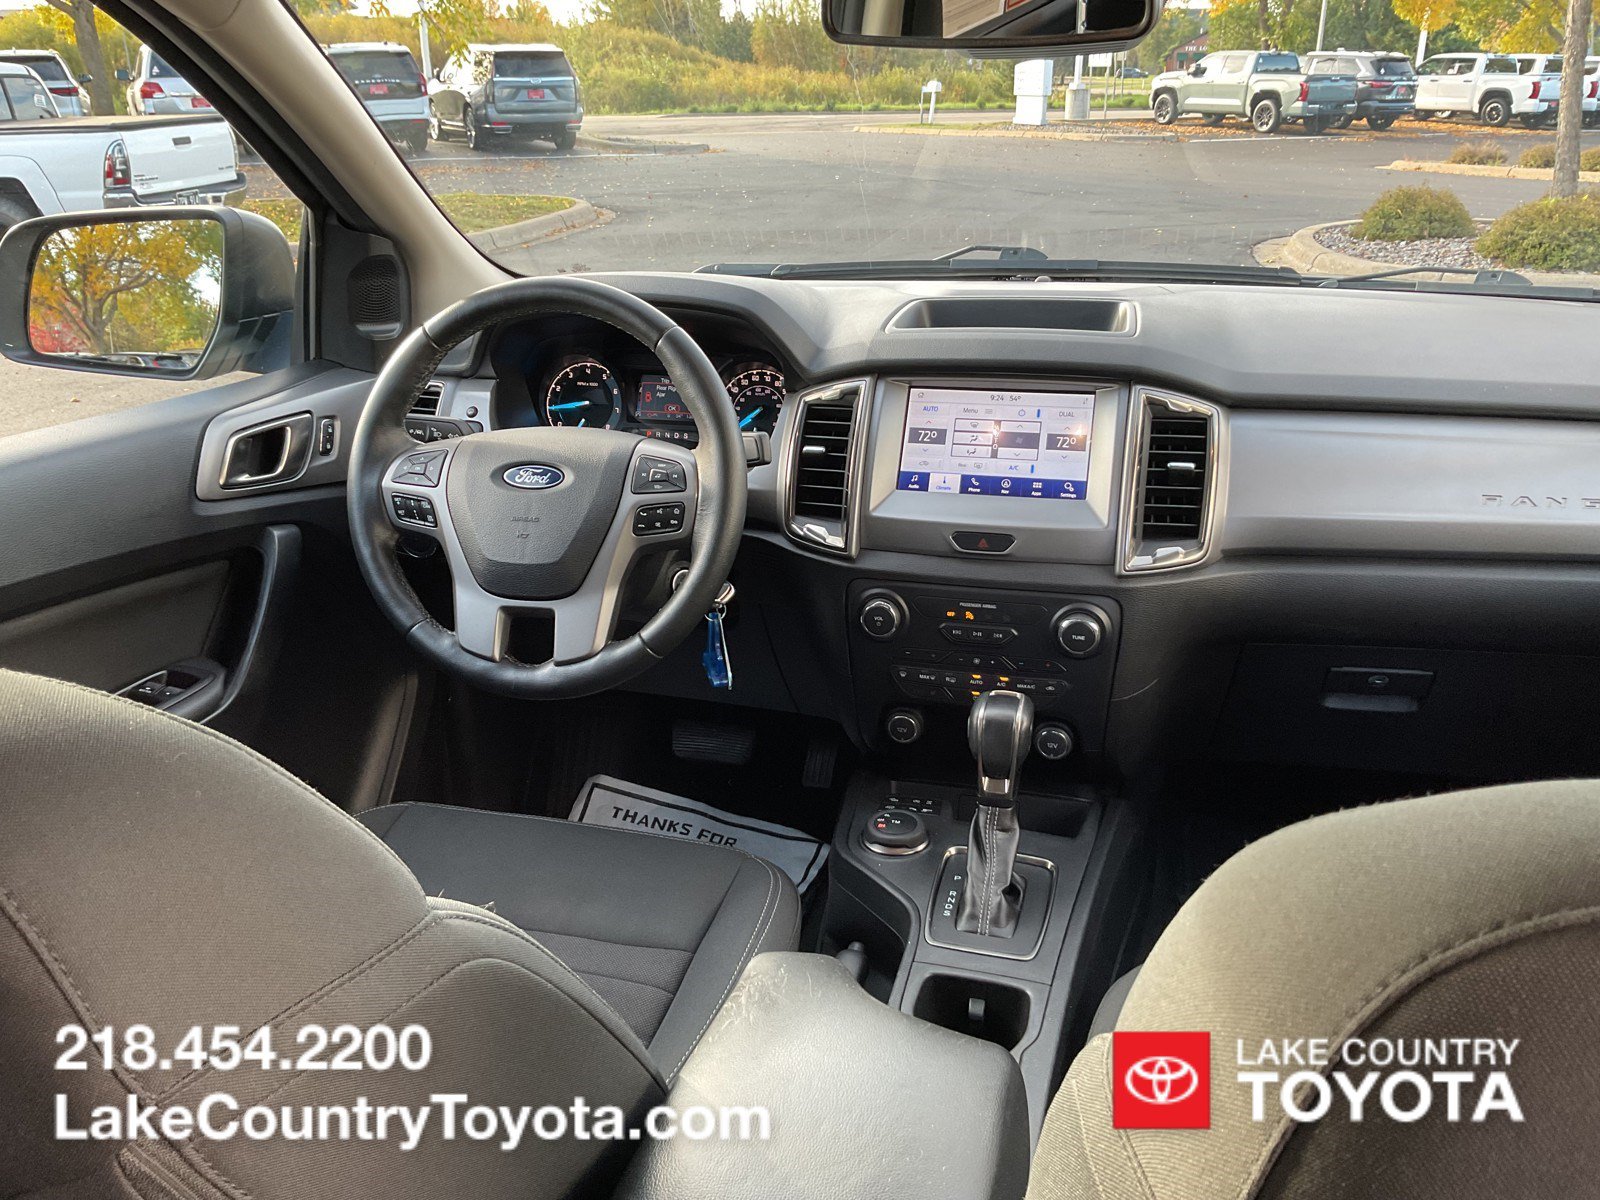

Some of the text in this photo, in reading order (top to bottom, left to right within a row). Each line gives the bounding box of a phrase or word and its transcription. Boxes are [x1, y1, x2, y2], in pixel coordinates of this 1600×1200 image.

[918, 430, 937, 441] 72°
[1056, 437, 1076, 448] 72°
[515, 468, 551, 483] Ford
[612, 806, 738, 847] THANKS FOR
